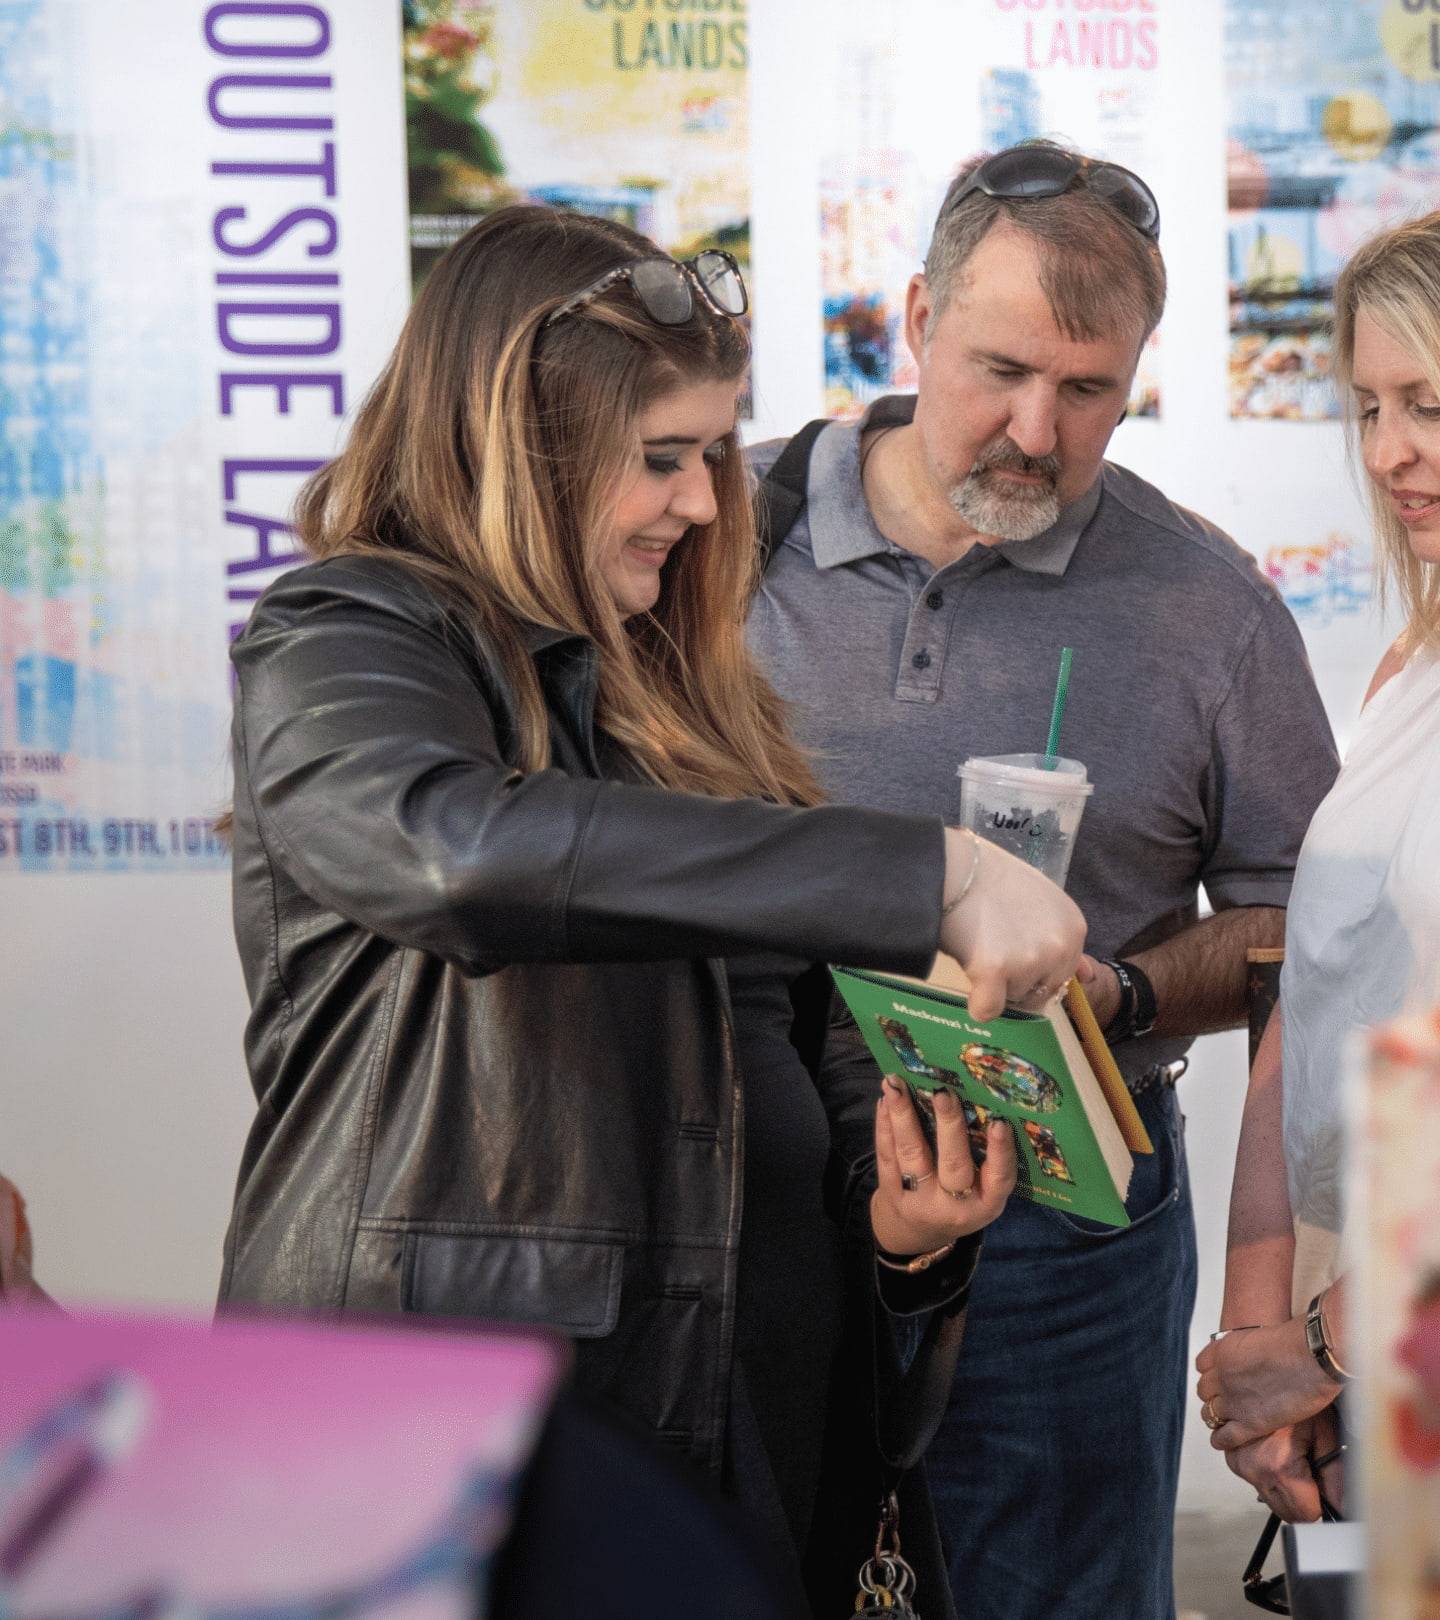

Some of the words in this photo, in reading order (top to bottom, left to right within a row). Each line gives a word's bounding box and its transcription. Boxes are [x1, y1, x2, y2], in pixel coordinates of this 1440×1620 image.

[613, 20, 748, 70] LANDS
[1024, 18, 1159, 70] LANDS
[203, 1, 346, 416] OUTSIDE
